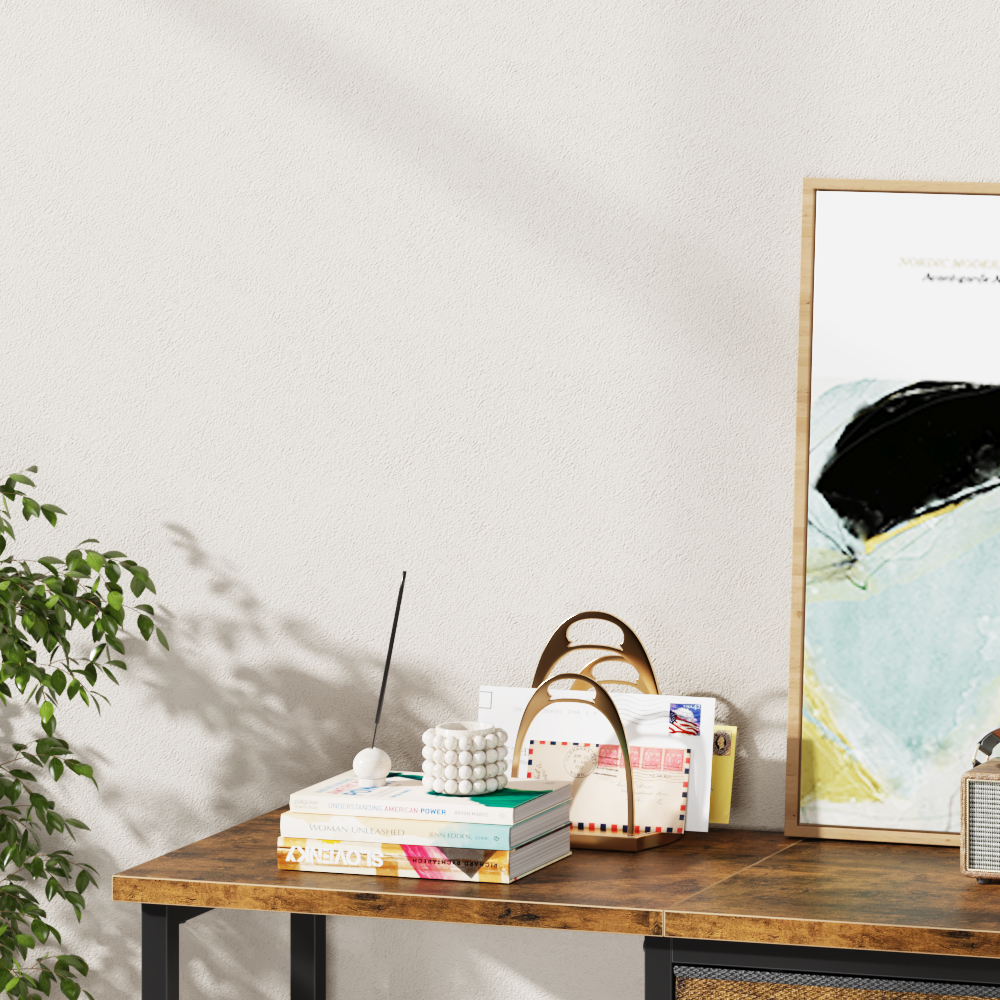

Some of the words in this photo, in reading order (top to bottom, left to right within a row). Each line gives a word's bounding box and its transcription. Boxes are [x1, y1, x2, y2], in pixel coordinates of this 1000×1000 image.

[327, 802, 384, 812] UNDERSTANDING
[384, 805, 419, 814] AMERICAN
[420, 807, 447, 816] POWER
[309, 823, 348, 834] WOMAN
[351, 826, 406, 837] UNLEASHED
